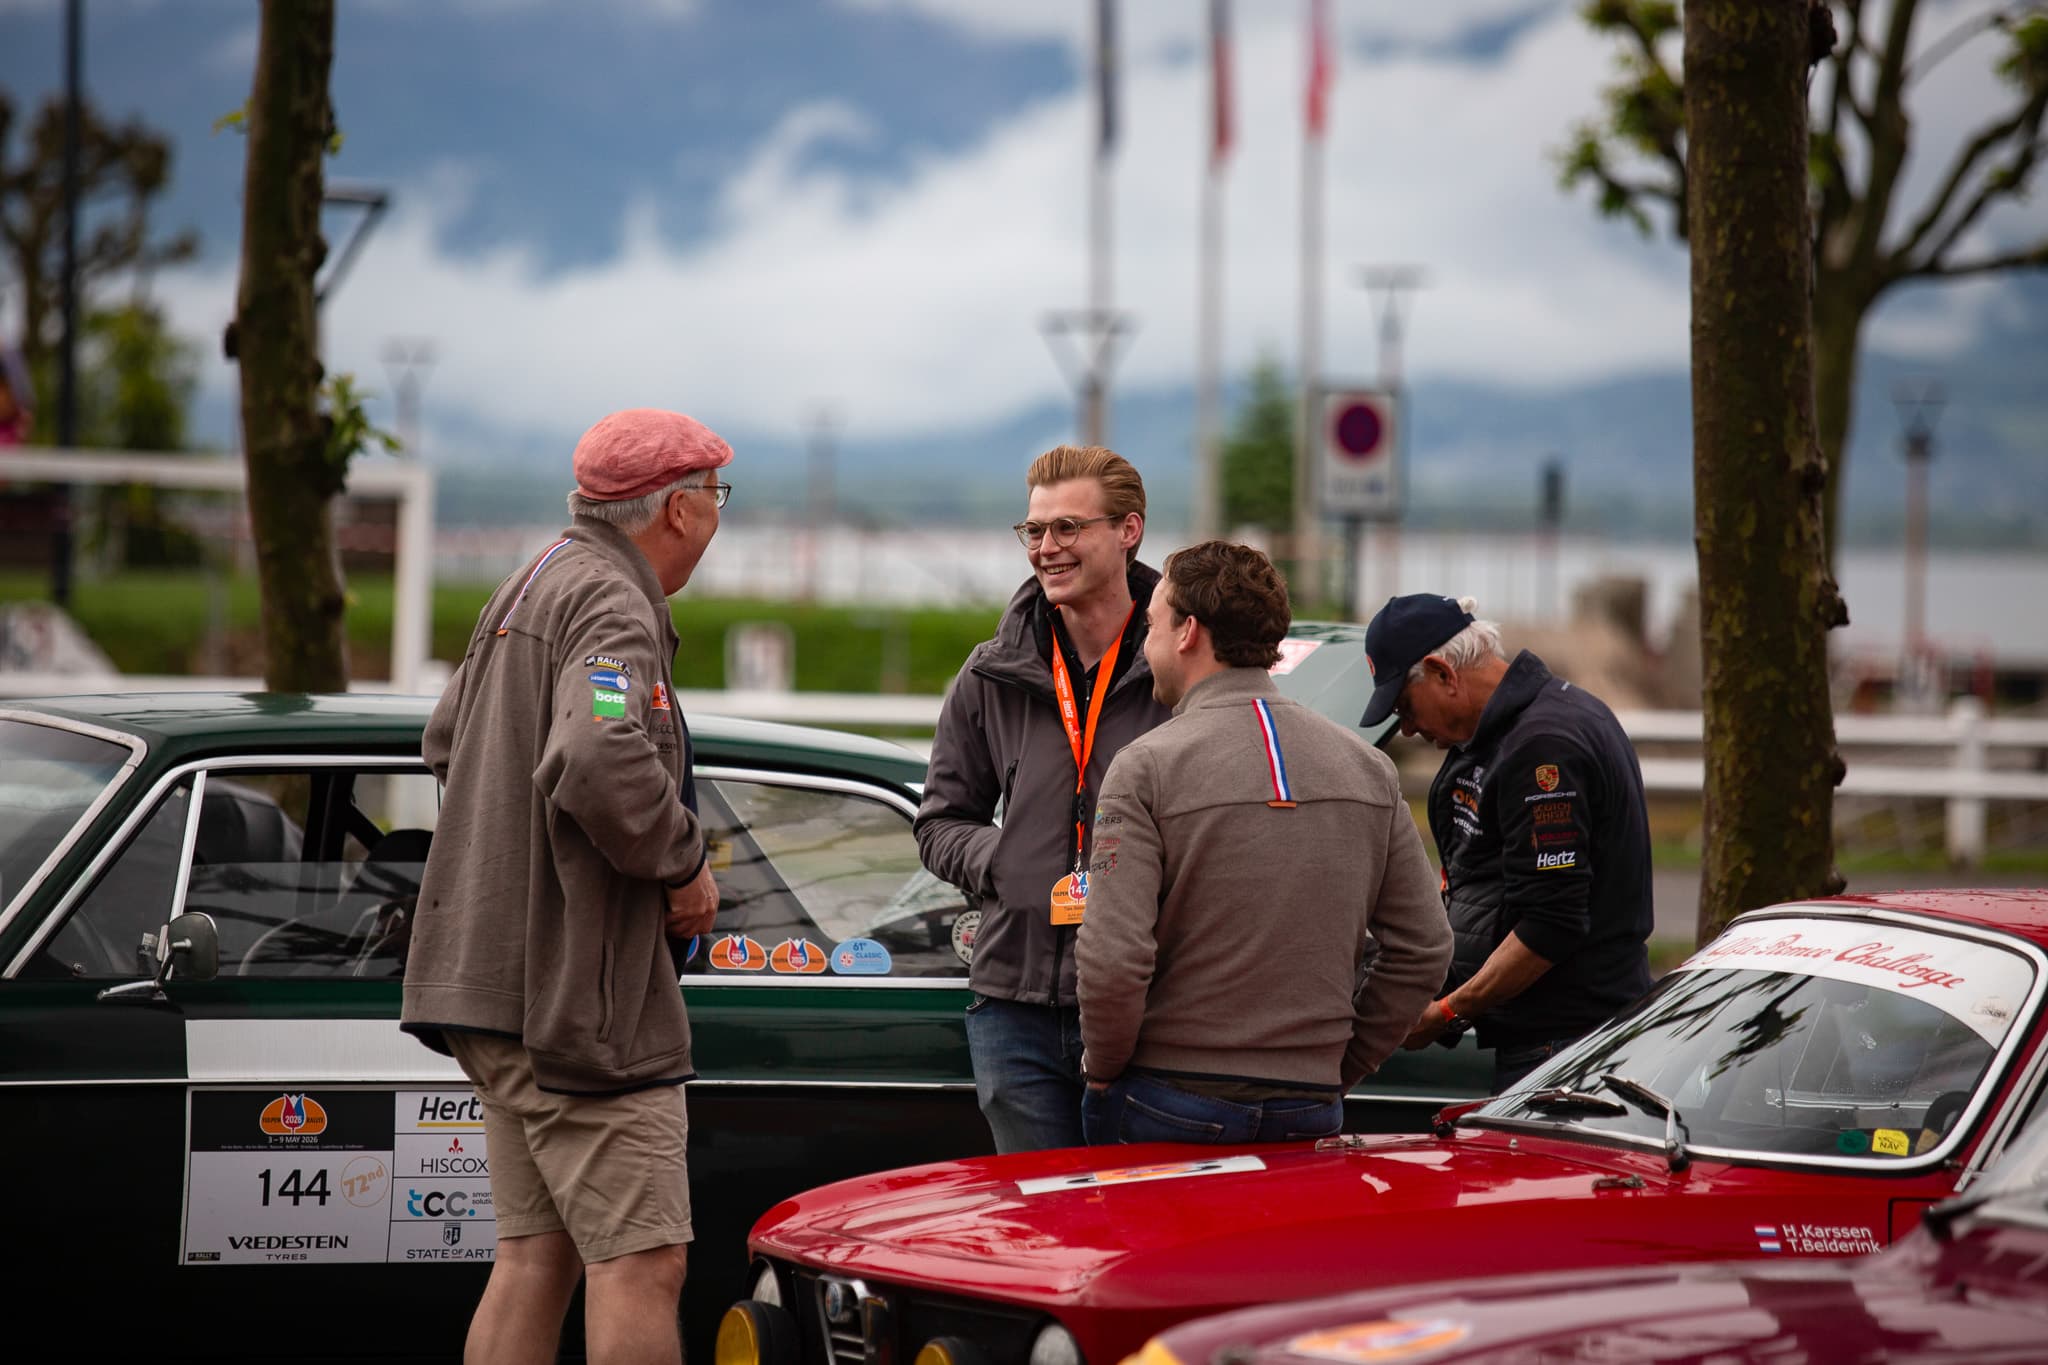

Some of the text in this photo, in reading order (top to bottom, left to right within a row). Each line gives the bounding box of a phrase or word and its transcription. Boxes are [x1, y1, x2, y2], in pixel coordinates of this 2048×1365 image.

[597, 656, 623, 667] RALLY
[595, 691, 626, 704] bott
[1536, 850, 1576, 868] Hertz
[1070, 884, 1088, 895] 147
[284, 1115, 303, 1124] 2026
[285, 1136, 300, 1144] MAY
[301, 1136, 319, 1144] 2026
[420, 1158, 489, 1174] HISCOX
[258, 1165, 385, 1207] 144 72nd
[228, 1235, 349, 1250] VREDESTEIN
[265, 1253, 308, 1261] TYRES
[406, 1248, 495, 1259] STATE OF ART
